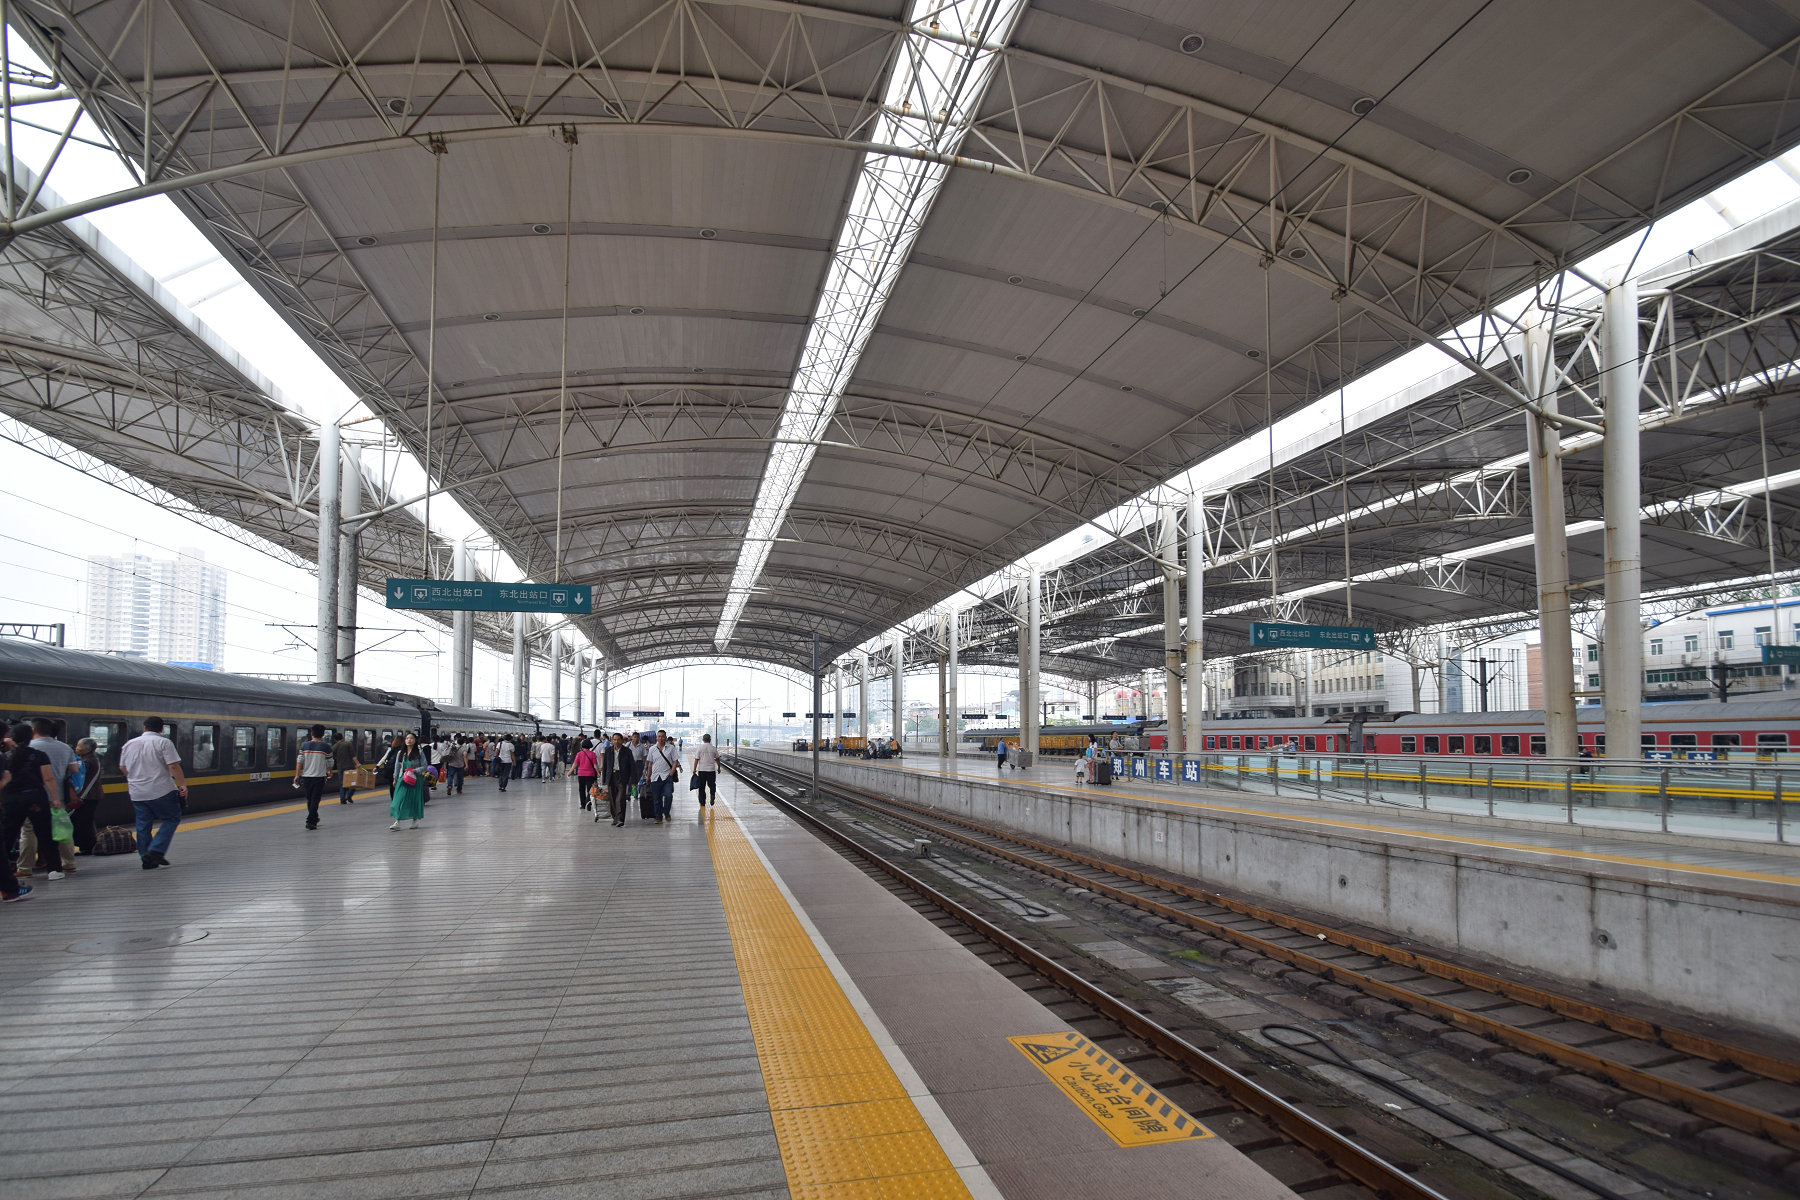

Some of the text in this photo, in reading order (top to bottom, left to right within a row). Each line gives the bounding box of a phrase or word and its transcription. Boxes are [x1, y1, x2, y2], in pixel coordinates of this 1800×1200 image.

[431, 587, 483, 597] 西北出站口
[499, 589, 548, 599] 东北出站口
[1113, 758, 1198, 782] 郑州车站
[1068, 1061, 1168, 1133] 小心站台间隙
[1092, 1102, 1114, 1119] Gap
